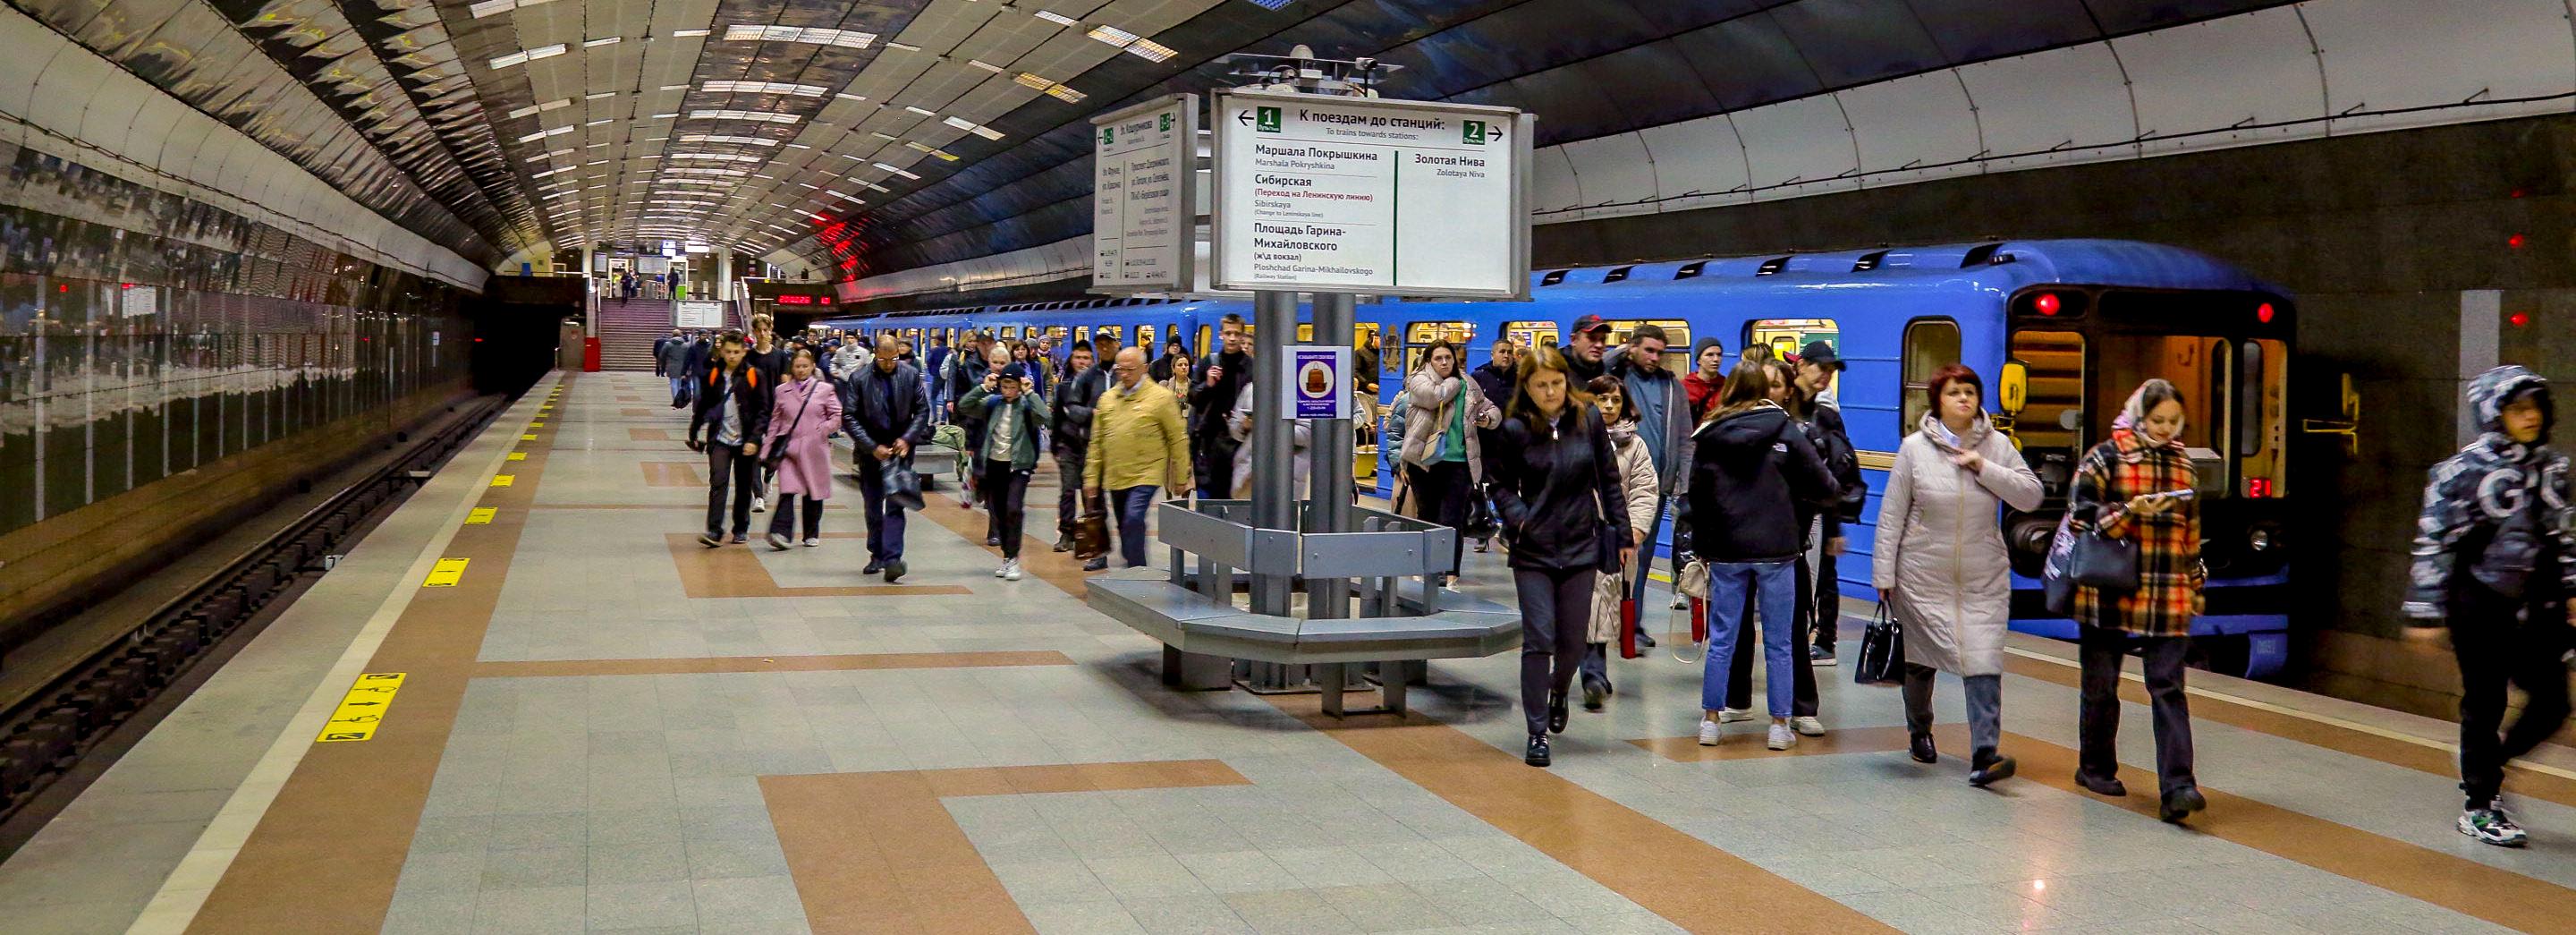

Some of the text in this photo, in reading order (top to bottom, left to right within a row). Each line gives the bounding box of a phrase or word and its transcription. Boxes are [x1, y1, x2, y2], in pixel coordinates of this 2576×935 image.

[1264, 109, 1274, 125] 1
[1300, 108, 1445, 131] К поездам до станций:
[1326, 127, 1419, 140] To trains towards stations:
[1470, 123, 1479, 138] 2
[1255, 144, 1377, 161] Маршала Покрышкина
[1255, 158, 1335, 170] Marshala Pokryshkina
[1415, 154, 1485, 167] Золотая Нива
[1436, 168, 1467, 178] Zolotaya
[1255, 174, 1312, 187] Сибирская
[1255, 188, 1291, 198] (Переход
[1302, 191, 1344, 201] Ленинскую
[1345, 193, 1374, 202] линию)
[1254, 200, 1291, 209] Sibirskaya
[1254, 223, 1346, 237] Площадь Гарина-
[1254, 237, 1338, 251] Михайловского
[1273, 253, 1302, 262] вокзал)
[1254, 263, 1374, 276] Ploshchad Garina-Mikhailovskogo
[2250, 479, 2271, 497] 21
